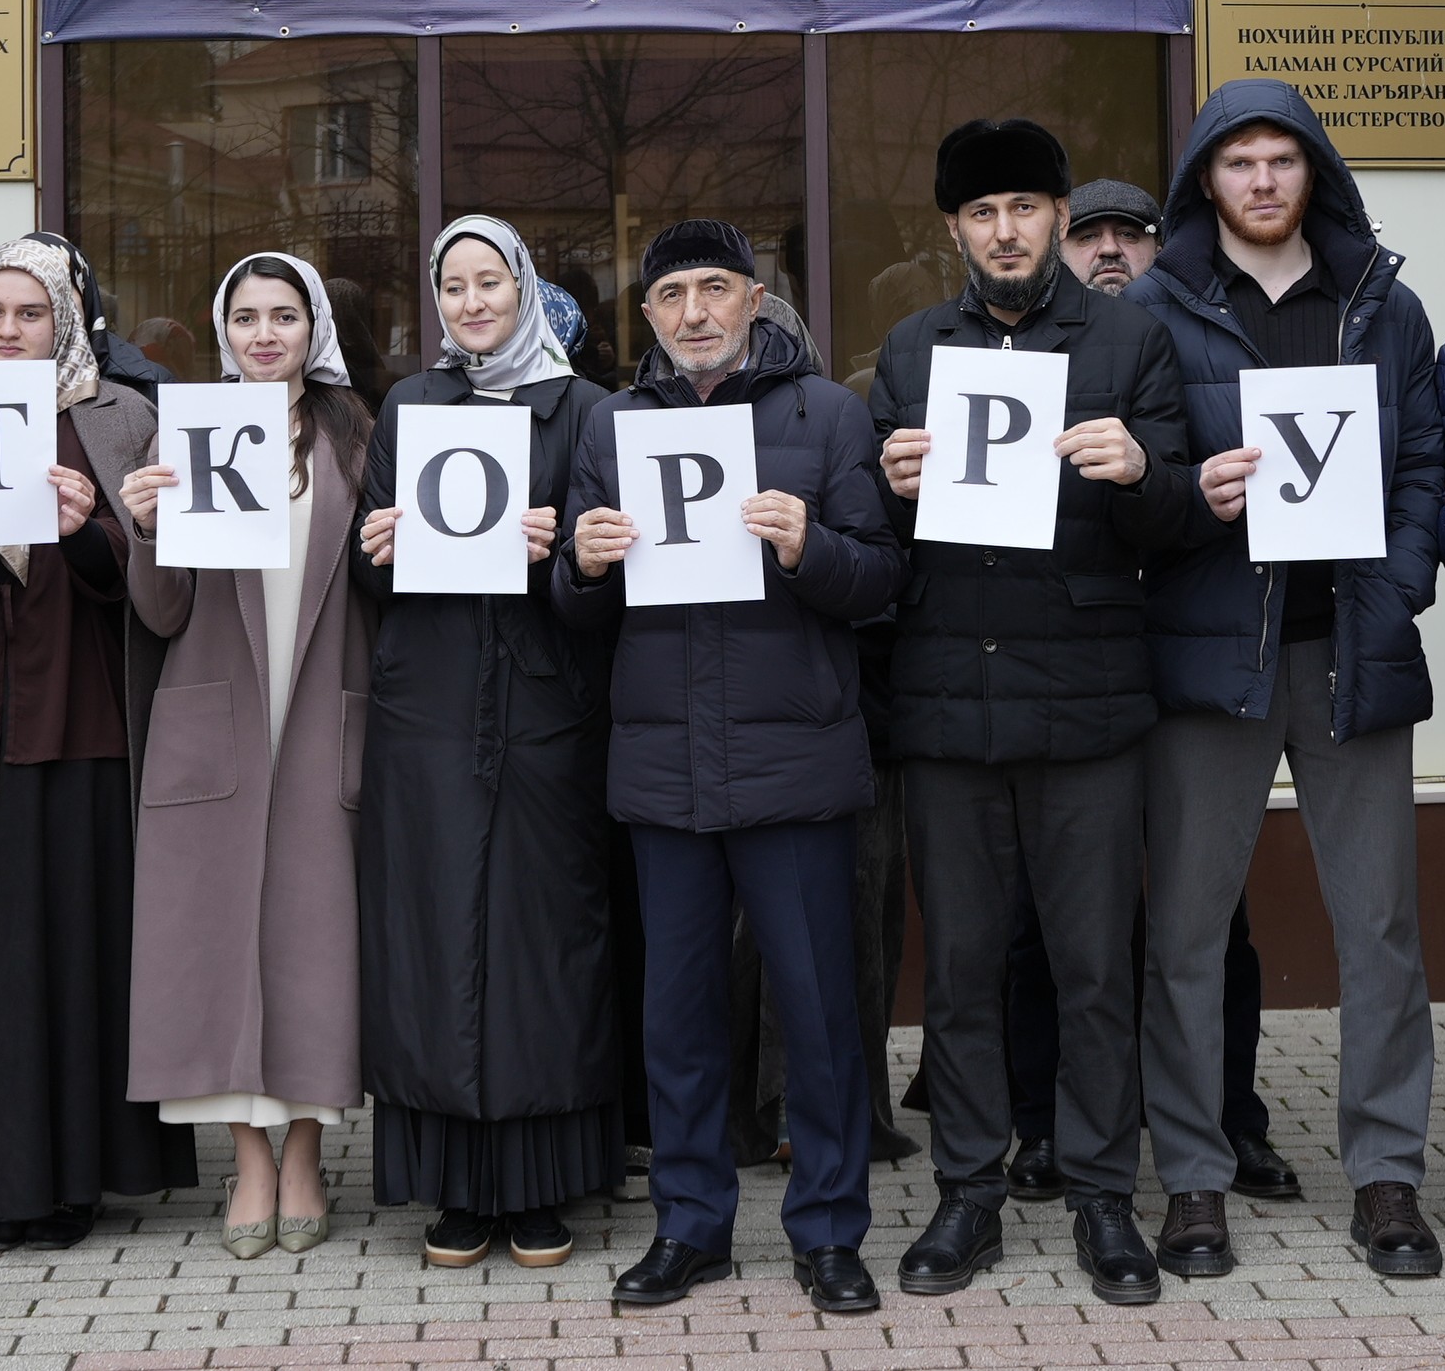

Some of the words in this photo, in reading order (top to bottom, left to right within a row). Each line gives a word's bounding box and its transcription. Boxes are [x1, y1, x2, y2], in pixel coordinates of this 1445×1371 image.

[1238, 24, 1335, 45] НОХЧИЙН
[1317, 112, 1445, 127] НИСТЕРСТВО
[177, 424, 270, 514] К
[416, 447, 510, 538] О
[646, 452, 725, 546] Р
[952, 392, 1032, 486] Р
[1259, 410, 1357, 504] У
